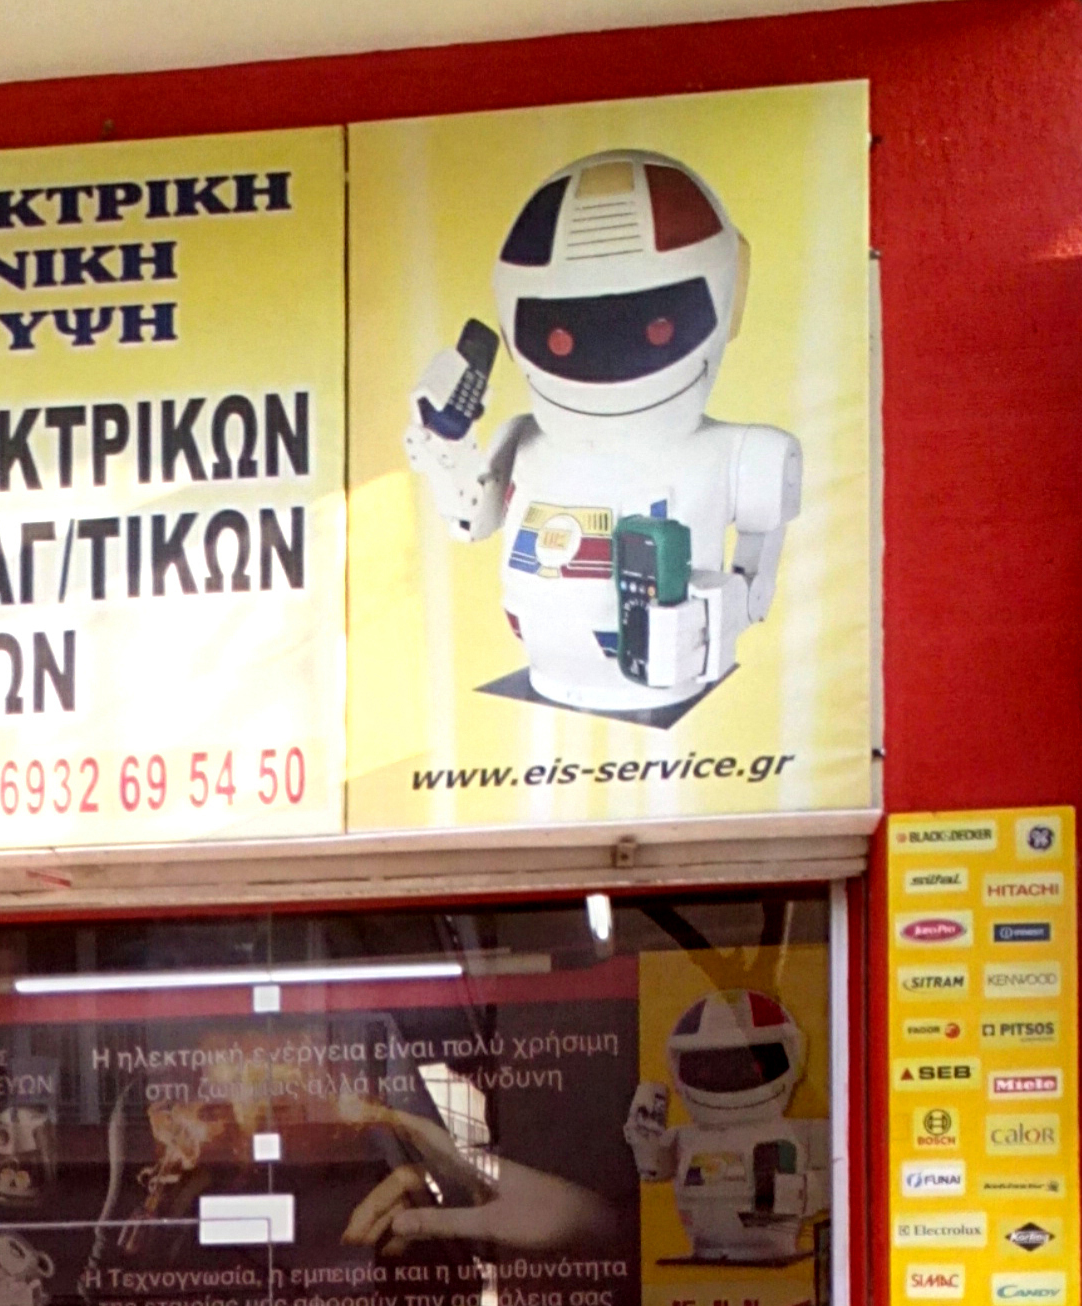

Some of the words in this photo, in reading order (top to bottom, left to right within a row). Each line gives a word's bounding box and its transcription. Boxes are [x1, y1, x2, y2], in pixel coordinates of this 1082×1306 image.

[411, 752, 795, 791] www.eis-service.gr
[0, 758, 99, 814] 6932
[120, 755, 166, 810] 69
[190, 750, 234, 807] 54
[258, 746, 305, 804] 50
[987, 883, 1059, 897] HITACHI
[911, 976, 964, 989] SITRAM
[987, 973, 1057, 986] KENWOOD
[999, 1022, 1054, 1036] PITSOS
[92, 1048, 109, 1069] Η
[118, 1042, 243, 1072] ηλεκτρική
[252, 1040, 366, 1070] ενέργεια
[374, 1035, 435, 1060] είναι
[442, 1034, 504, 1057] πολύ
[513, 1031, 618, 1059] χρήσιμη
[919, 1065, 972, 1079] SEB
[145, 1081, 189, 1101] στη
[378, 1074, 416, 1092] και
[994, 1077, 1056, 1092] Miele
[917, 1137, 956, 1146] BOSCH
[924, 1174, 960, 1185] FUNAI
[914, 1225, 982, 1236] Electrolux
[85, 1269, 101, 1288] Η
[290, 1260, 387, 1287] εμπειρία
[395, 1266, 429, 1281] και
[436, 1264, 449, 1284] η
[458, 1257, 628, 1281] υπυθυνότητα
